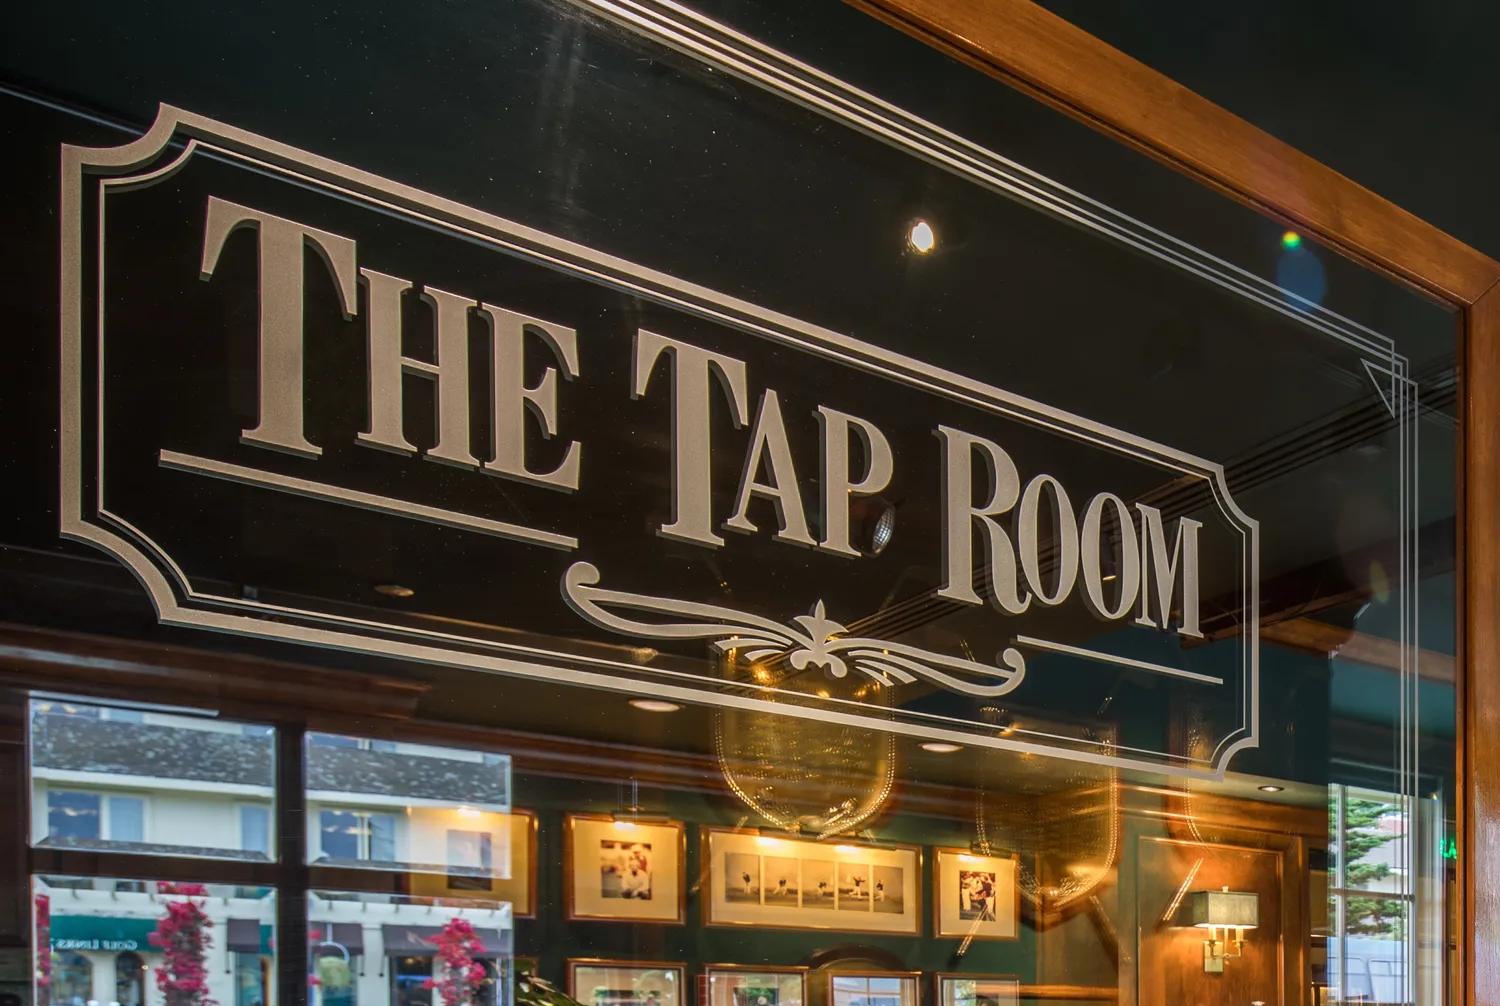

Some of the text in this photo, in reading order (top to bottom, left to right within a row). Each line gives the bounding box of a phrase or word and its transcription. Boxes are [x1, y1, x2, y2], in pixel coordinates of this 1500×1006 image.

[200, 195, 1205, 639] THE TAP ROOM
